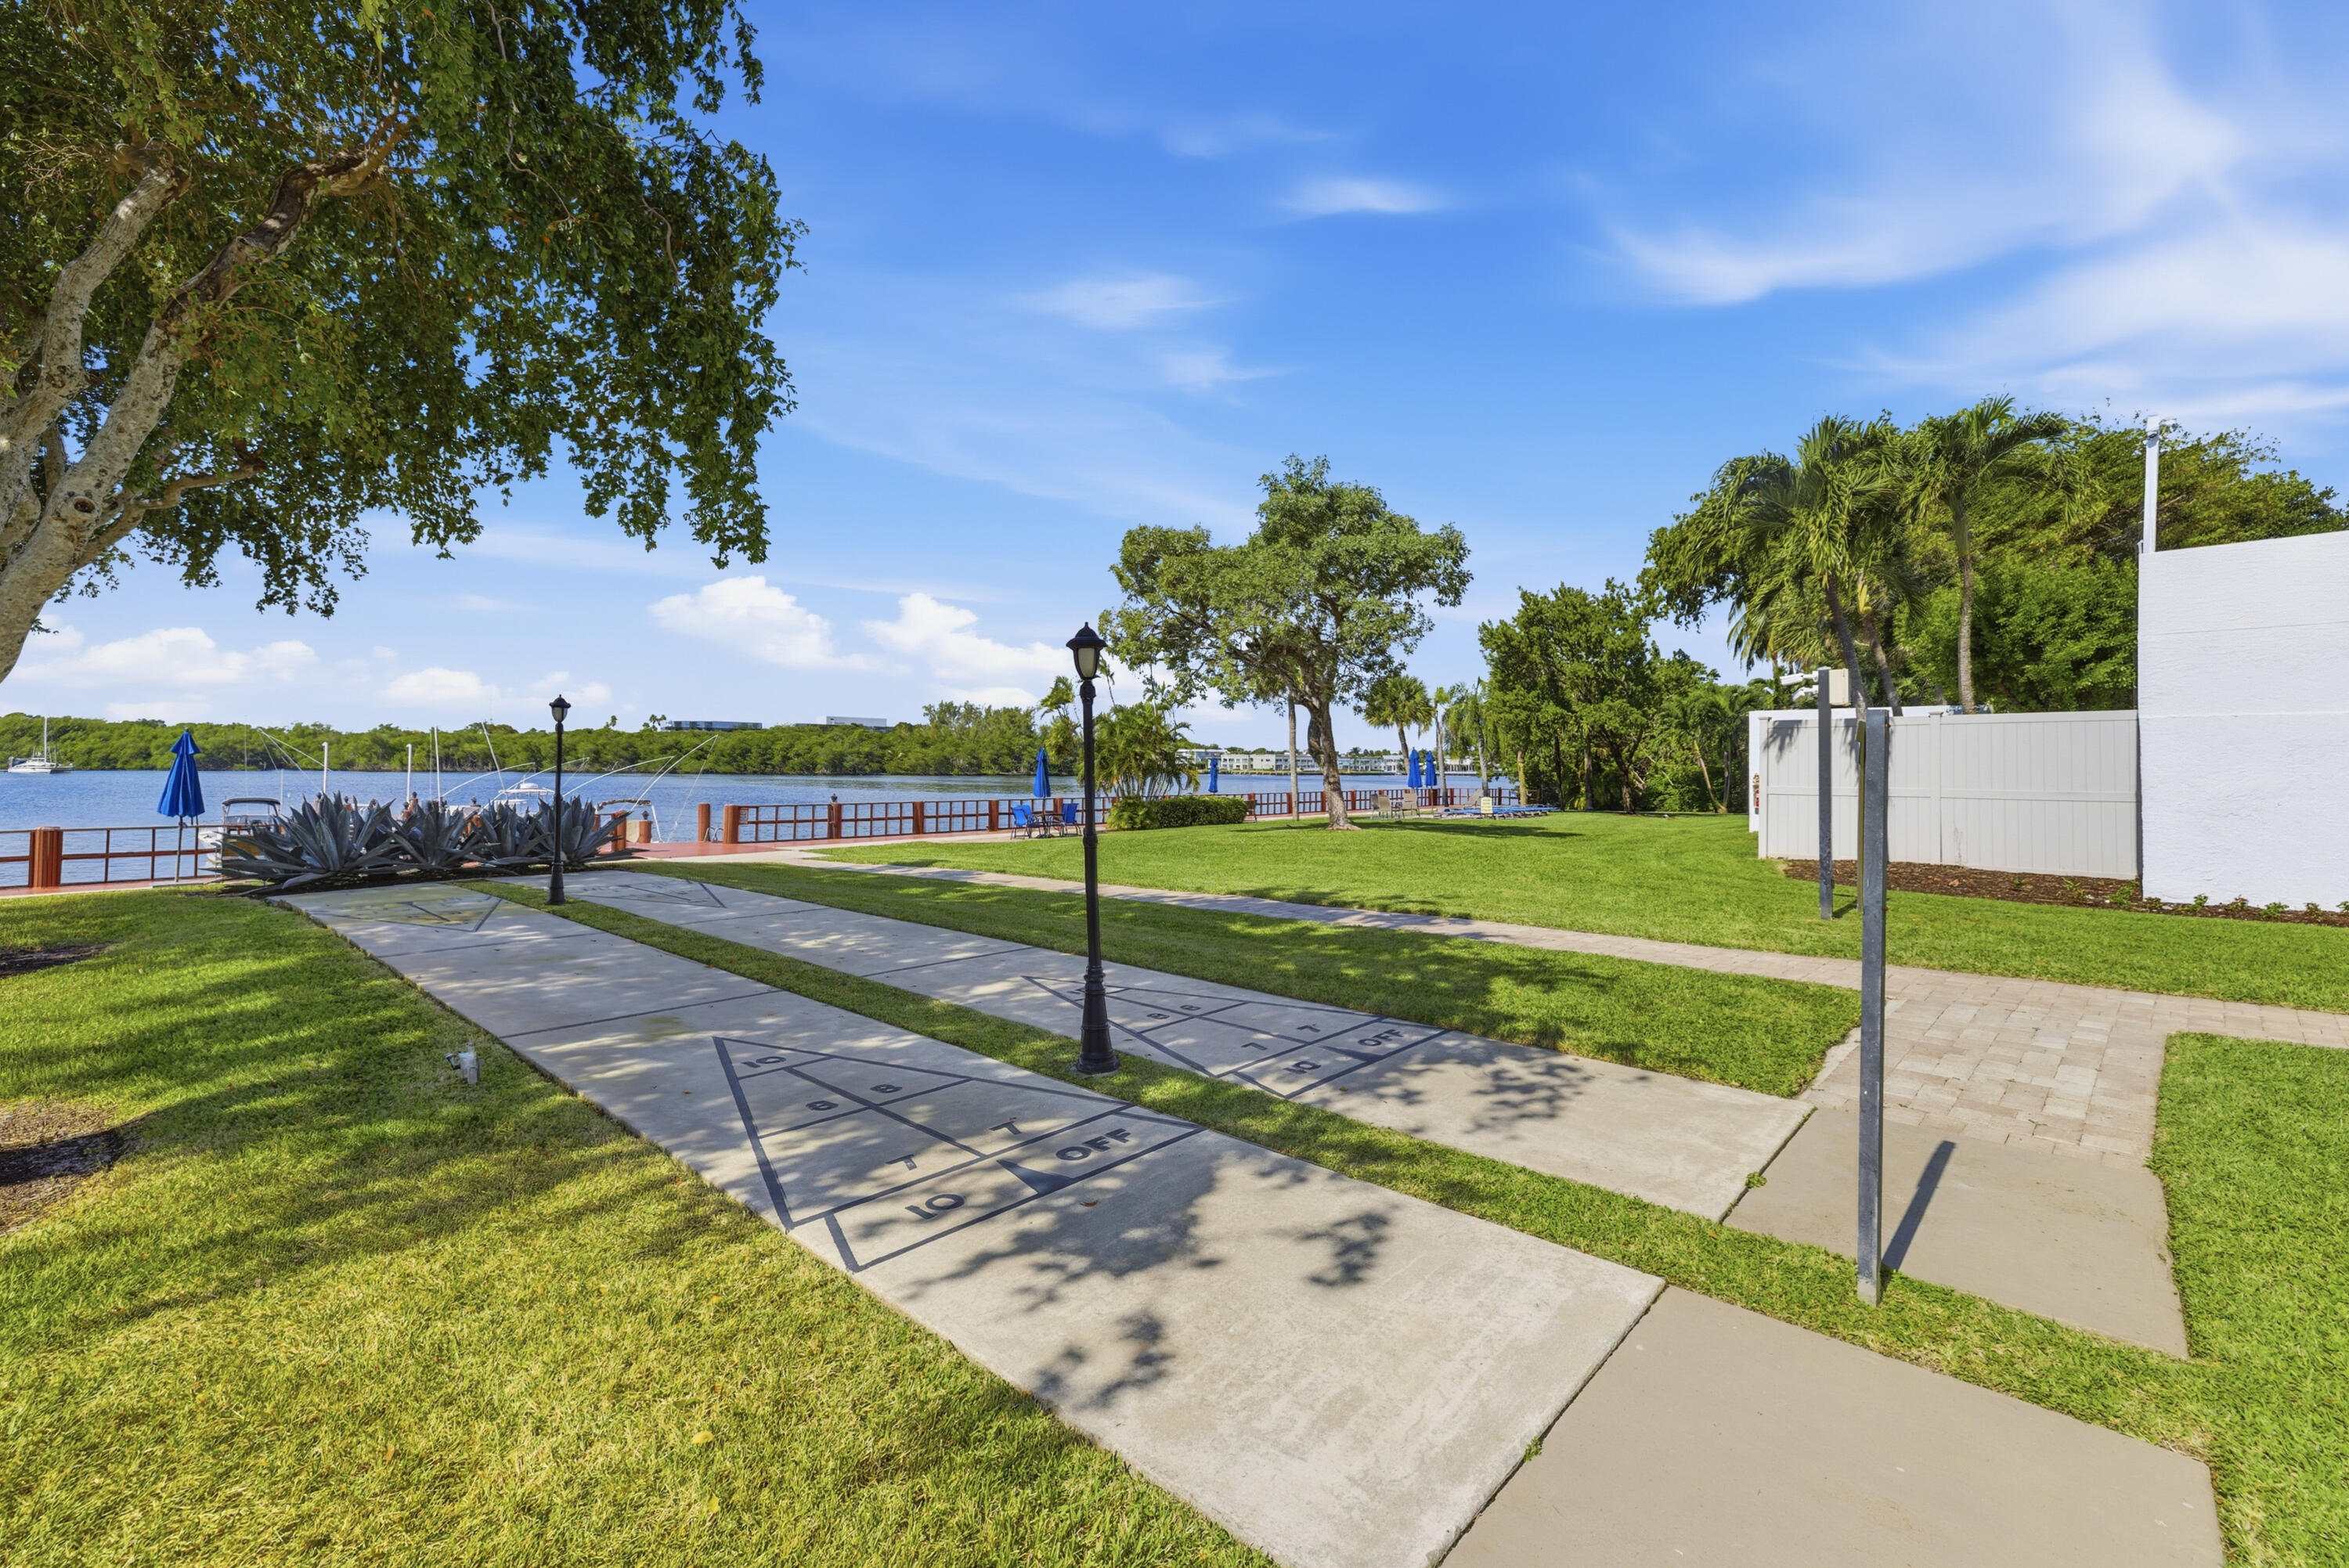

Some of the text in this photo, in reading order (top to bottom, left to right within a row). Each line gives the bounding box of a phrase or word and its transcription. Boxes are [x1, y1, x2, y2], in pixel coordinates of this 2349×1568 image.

[1357, 1029, 1404, 1047] OFF
[1241, 1042, 1268, 1051] 7
[742, 1056, 787, 1069] 10
[1283, 1060, 1322, 1075] 10
[870, 1083, 903, 1094] 8
[989, 1120, 1022, 1136] 7
[1055, 1127, 1131, 1162] OFF
[904, 1193, 966, 1220] 10
